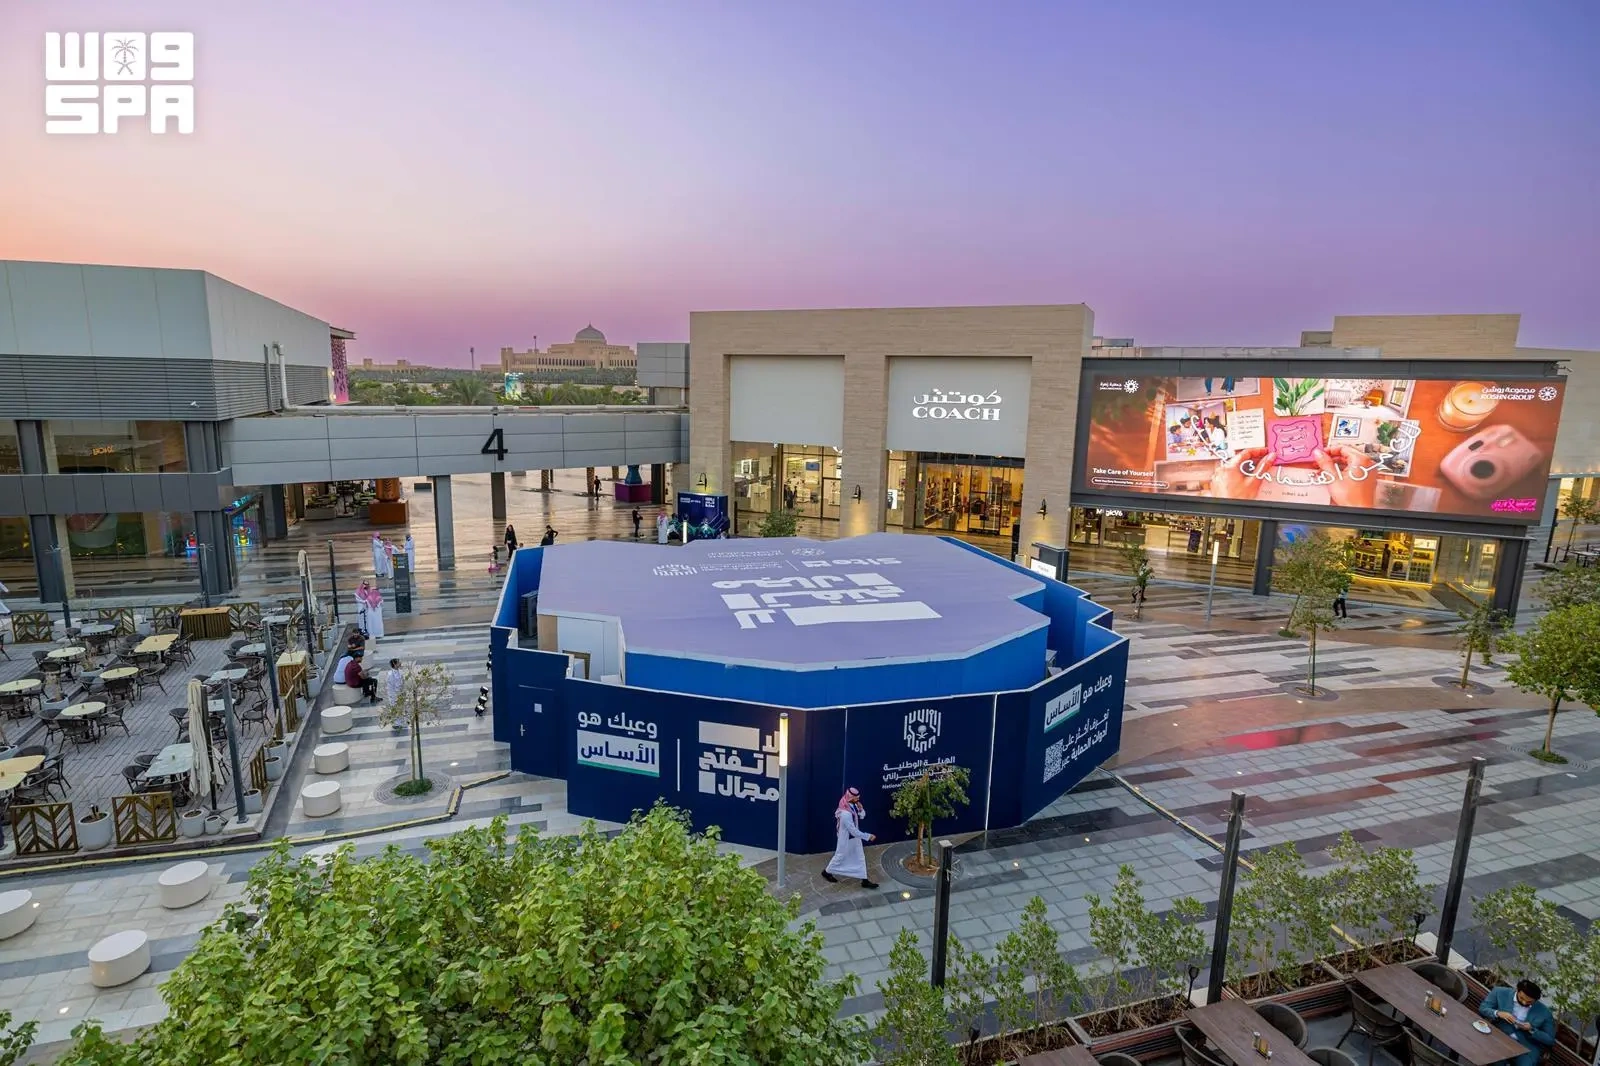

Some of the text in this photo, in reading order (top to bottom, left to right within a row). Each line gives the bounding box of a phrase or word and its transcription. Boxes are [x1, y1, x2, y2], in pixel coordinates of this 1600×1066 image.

[913, 388, 1003, 406] كوتش
[1505, 386, 1536, 394] مجموعة
[912, 406, 1001, 421] COACH
[481, 428, 509, 461] 4
[1239, 459, 1345, 486] اهتمامك
[1046, 674, 1113, 726] وعيك هو الأساس
[577, 710, 658, 740] وعيك هو
[1092, 720, 1109, 745] أدوات
[580, 740, 656, 765] الأساس
[1062, 732, 1075, 752] على
[1071, 736, 1092, 761] الحماية
[698, 747, 764, 775] تفتح
[883, 759, 923, 771] الوطنية
[718, 772, 780, 803] مجال
